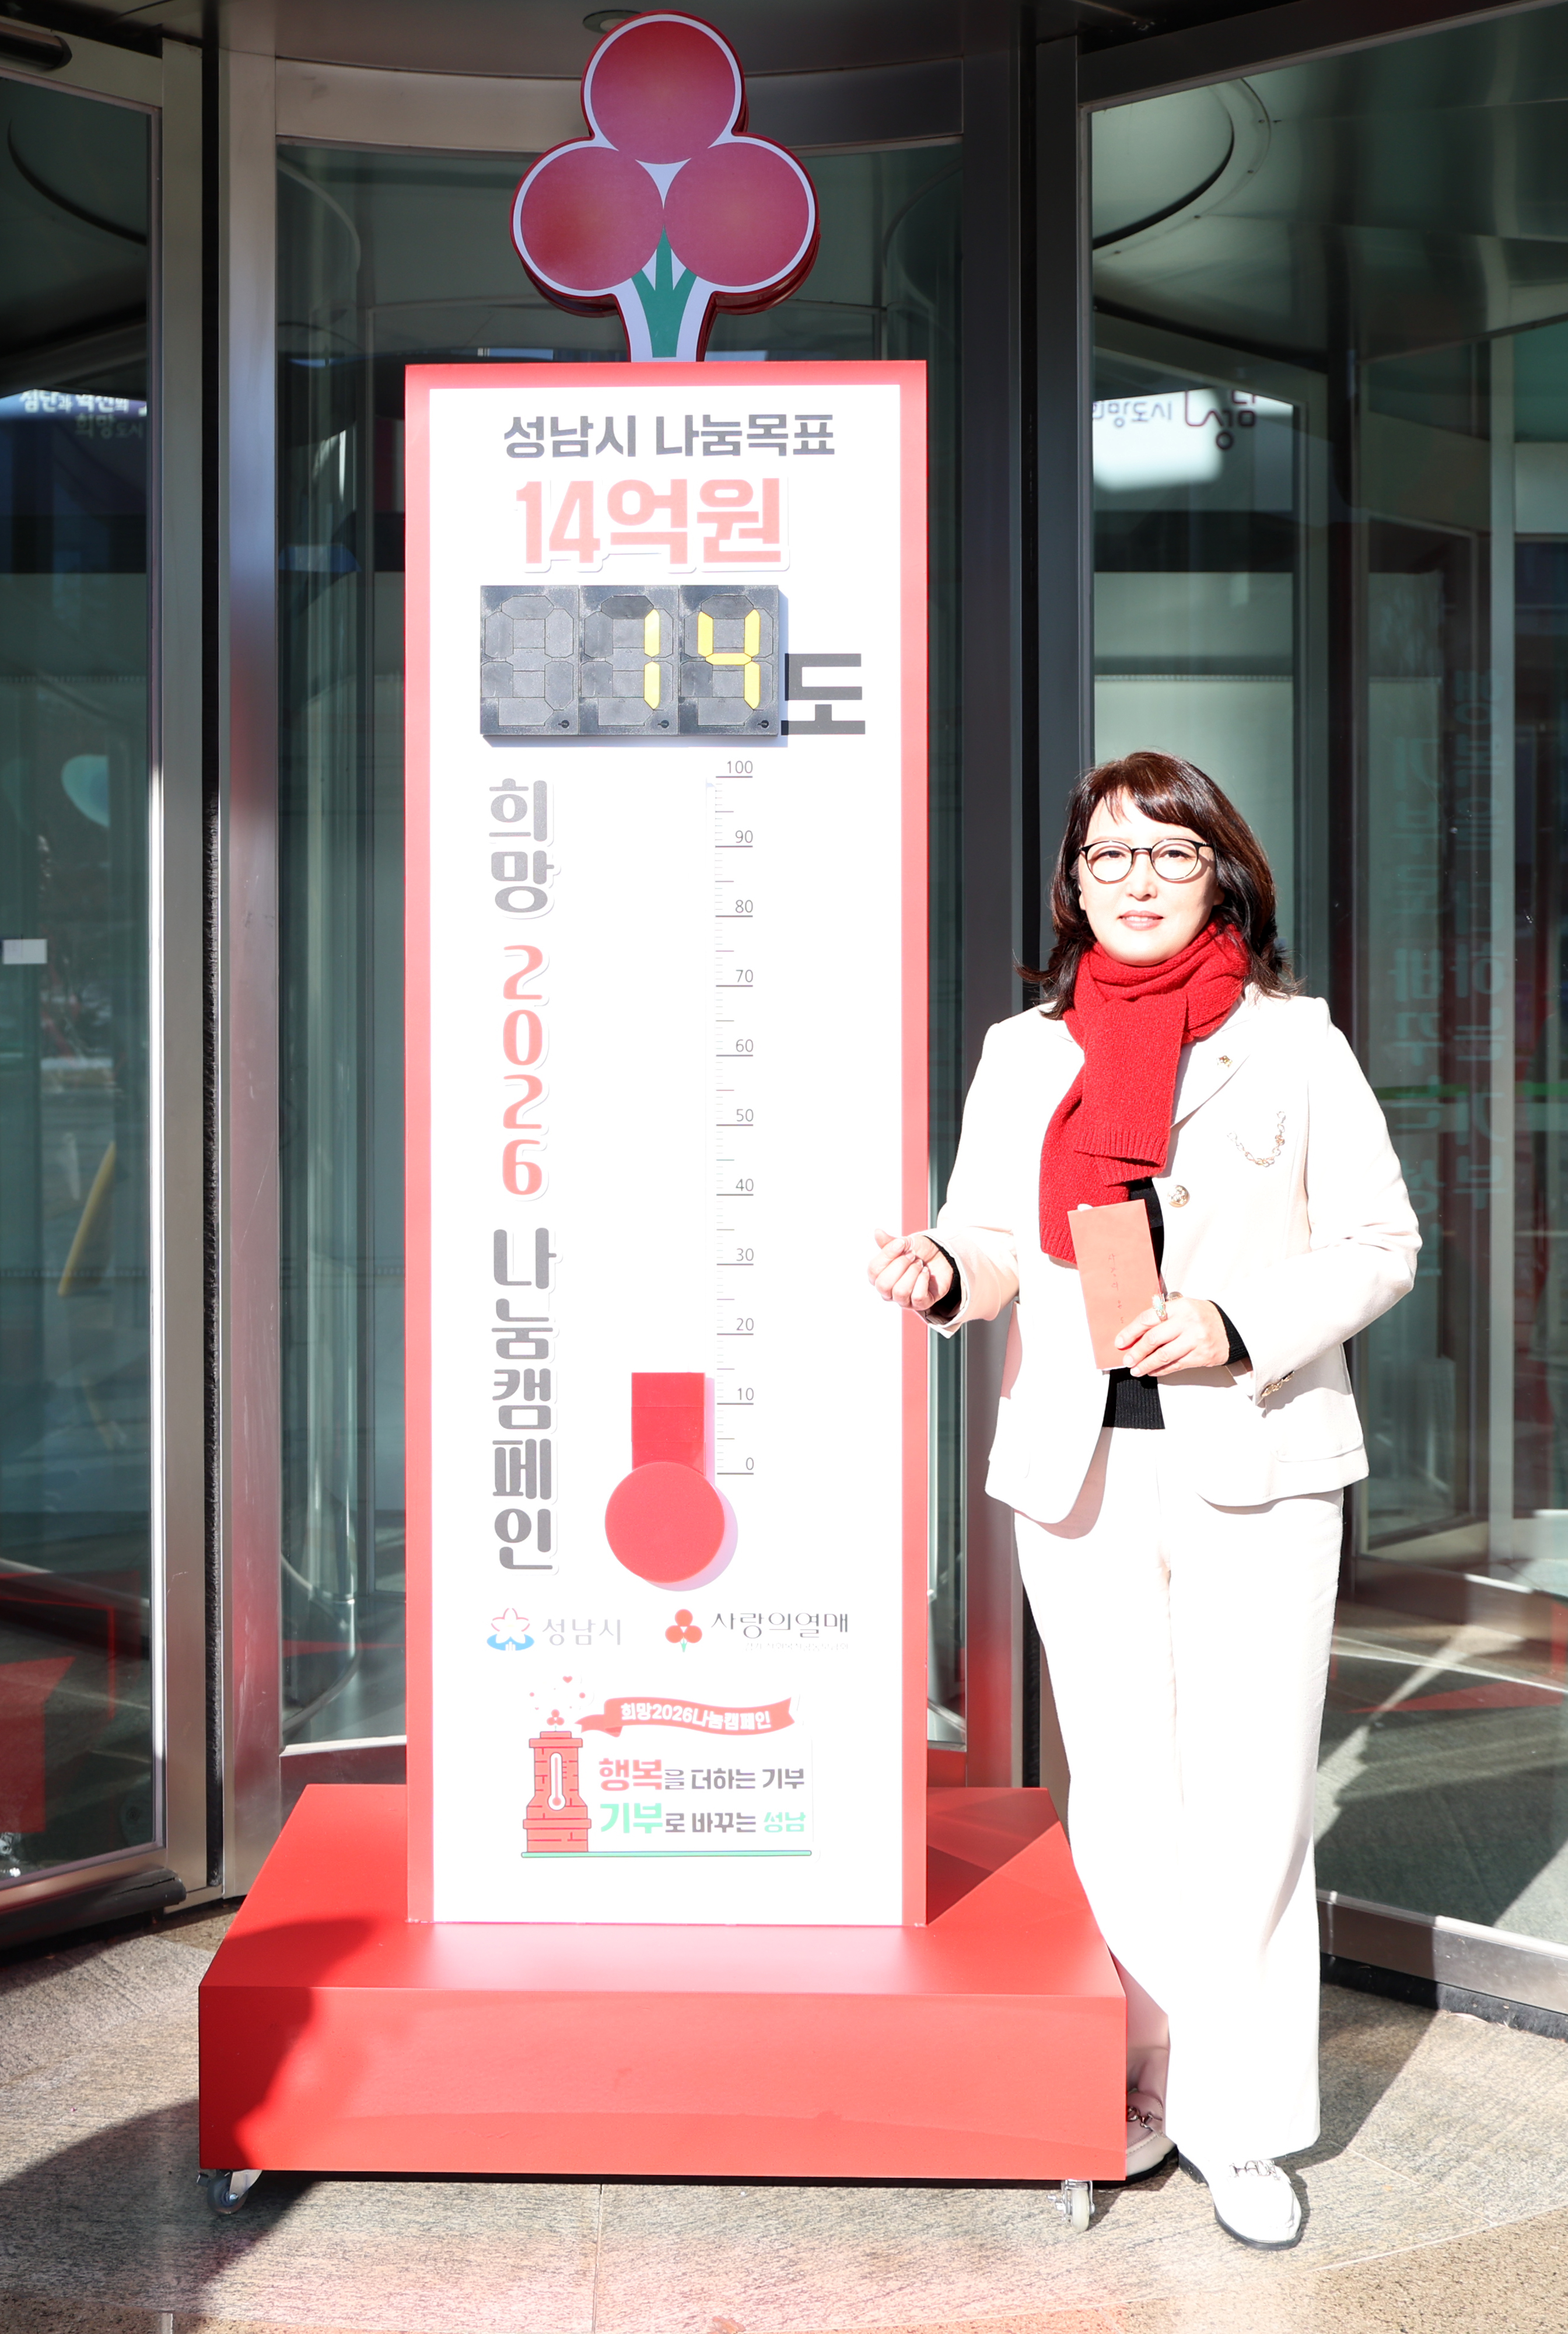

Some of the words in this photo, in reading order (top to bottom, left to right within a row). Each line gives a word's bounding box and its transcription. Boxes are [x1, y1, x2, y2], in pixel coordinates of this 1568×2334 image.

[504, 415, 636, 458] 성남시
[656, 414, 835, 457] 나눔목표
[516, 478, 781, 564] 14억원
[644, 609, 760, 710] 14
[782, 653, 866, 736] 도
[727, 760, 753, 774] 100
[735, 830, 754, 844] 90
[489, 778, 555, 913] 희망
[735, 900, 754, 913] 80
[736, 969, 754, 983] 70
[736, 1039, 754, 1053] 60
[502, 944, 544, 1196] 2026
[736, 1109, 754, 1122] 50
[736, 1178, 754, 1192] 40
[736, 1248, 754, 1261] 30
[736, 1318, 754, 1331] 20
[491, 1227, 557, 1570] 나눔캠페인
[737, 1387, 754, 1401] 10
[746, 1457, 754, 1470] 0
[542, 1618, 621, 1646] 성남시
[711, 1612, 848, 1638] 사랑의열매
[598, 1758, 685, 1791] 행복을
[691, 1767, 757, 1790] 더하는
[762, 1768, 805, 1790] 기부
[600, 1802, 685, 1834] 기부로
[691, 1812, 757, 1833] 바꾸는
[763, 1812, 806, 1833] 성남
